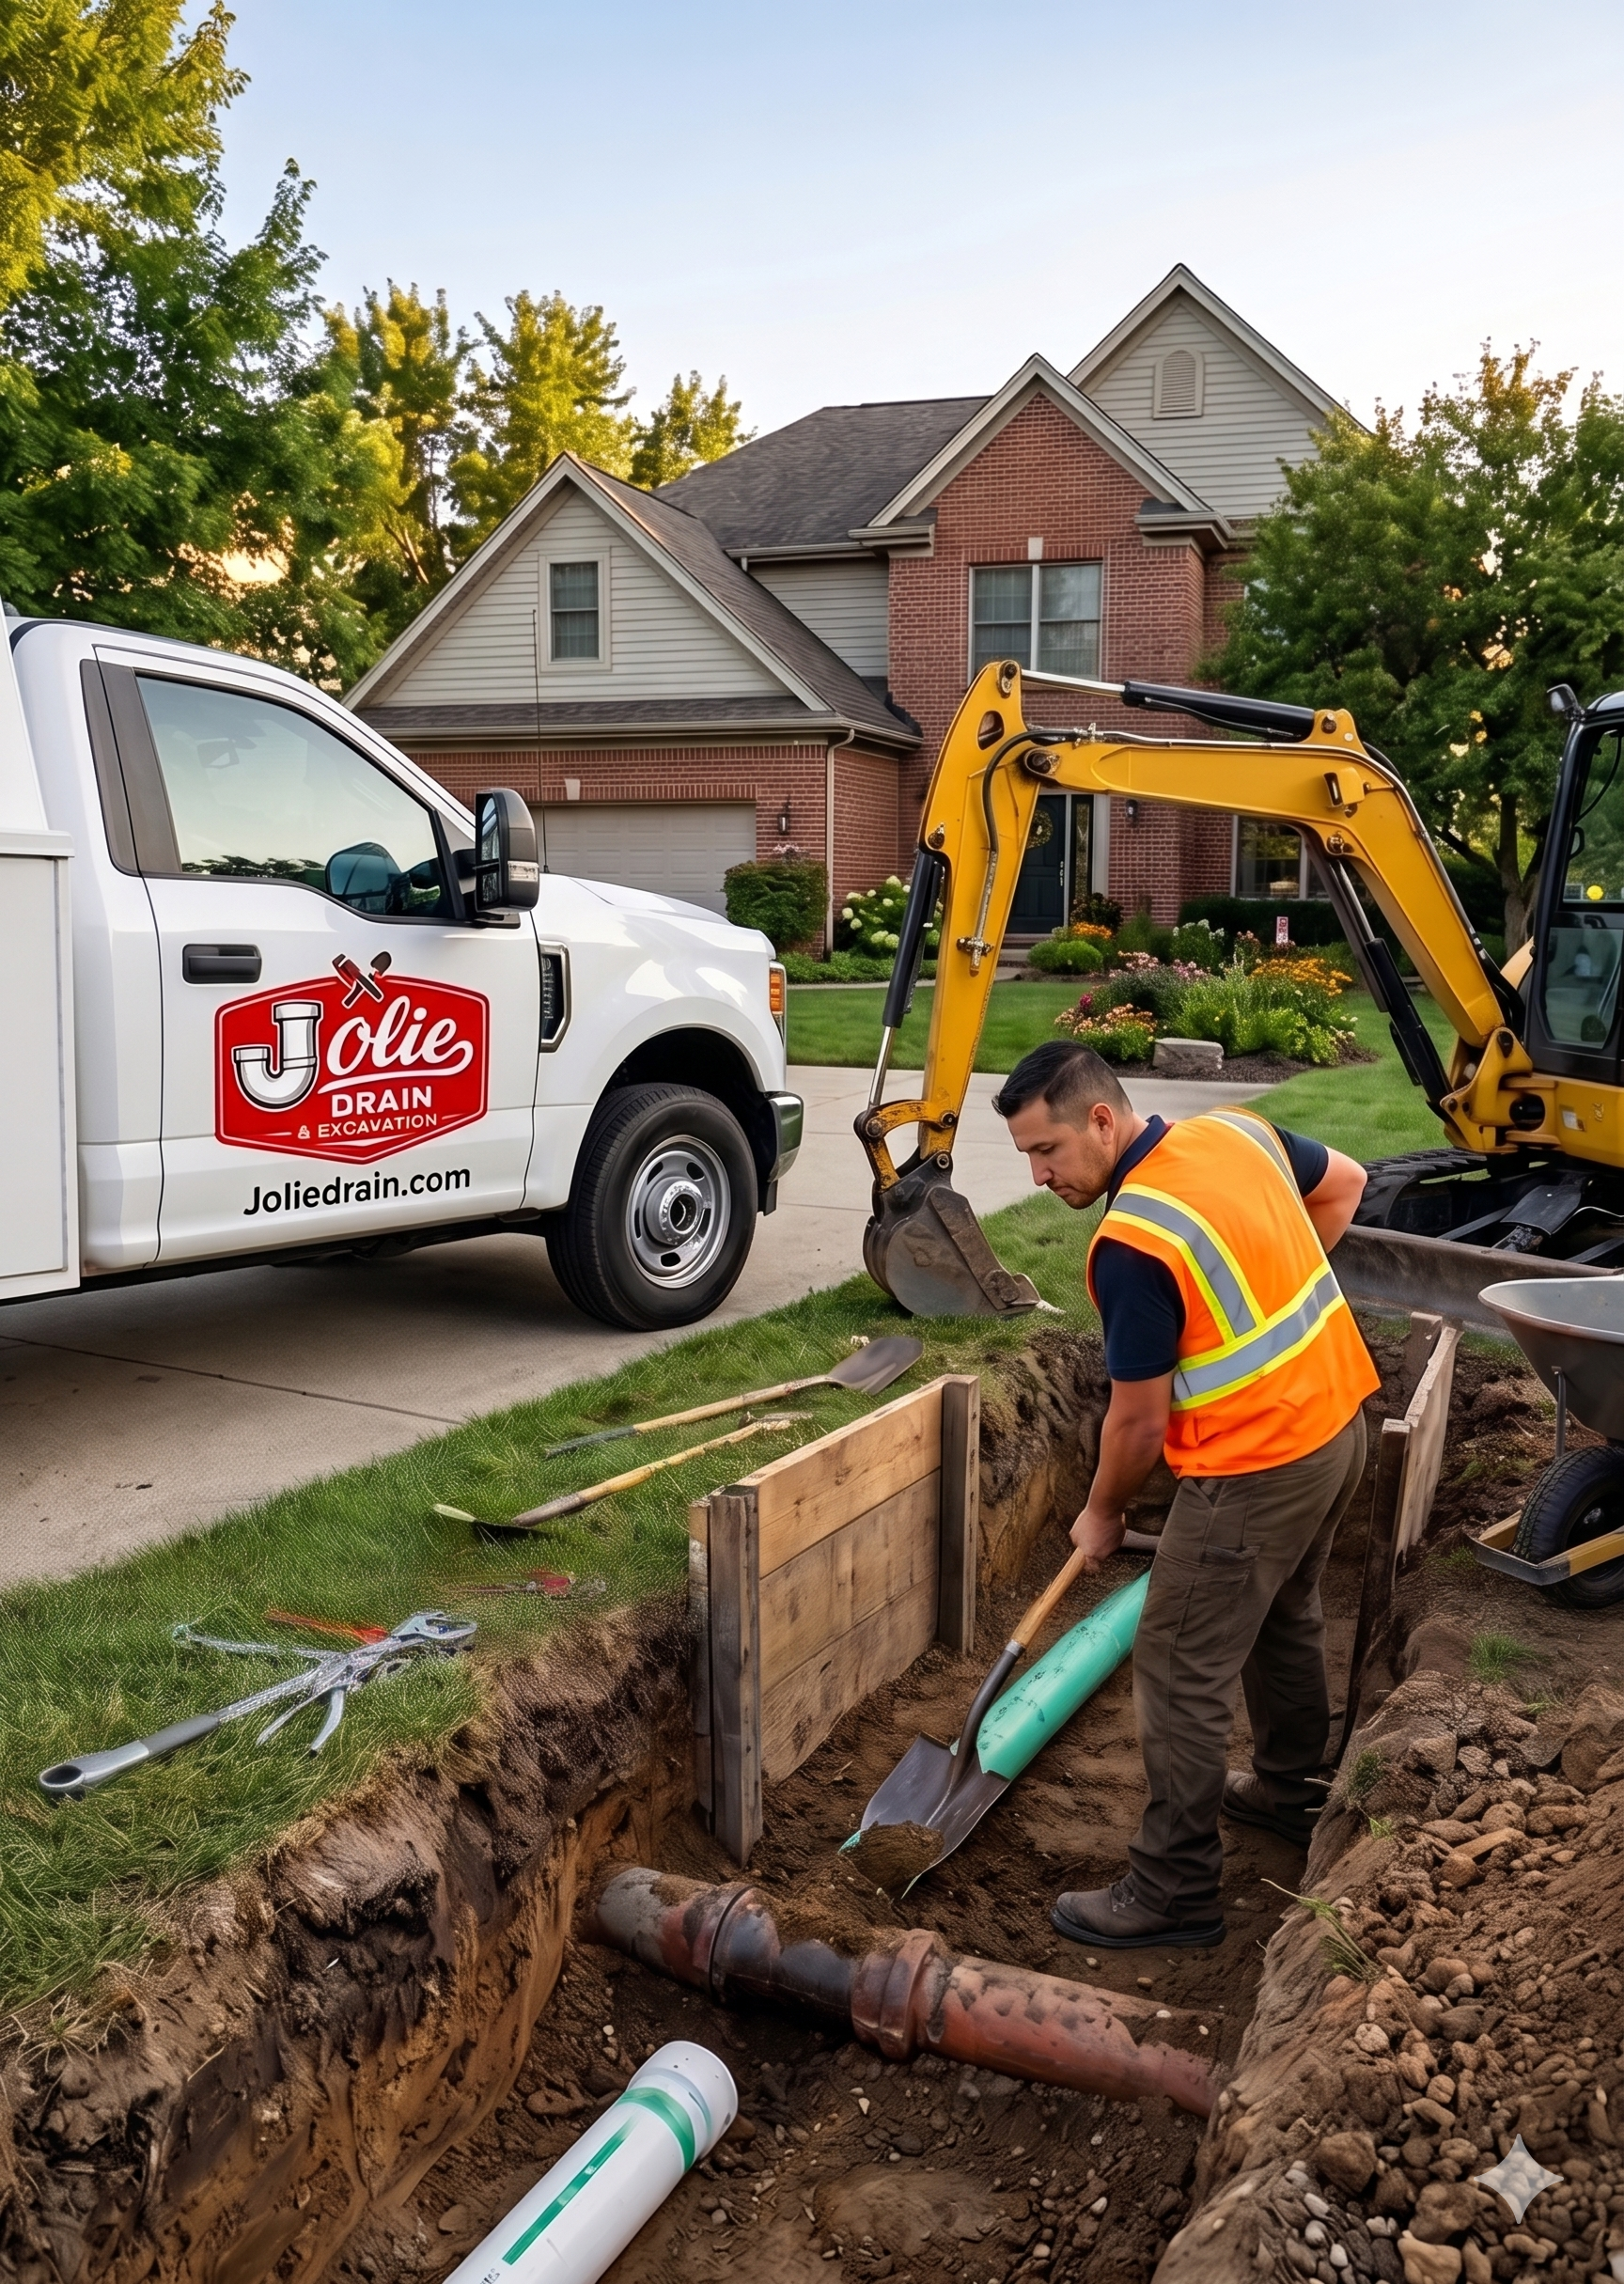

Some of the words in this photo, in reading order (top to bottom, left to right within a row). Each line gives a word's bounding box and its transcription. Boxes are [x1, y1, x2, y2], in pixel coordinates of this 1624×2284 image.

[232, 995, 473, 1111] Jolie
[332, 1086, 431, 1118] DRAIN
[298, 1125, 310, 1139] &
[318, 1114, 437, 1138] EXCAVATION
[243, 1168, 470, 1215] Joliedrain.com
